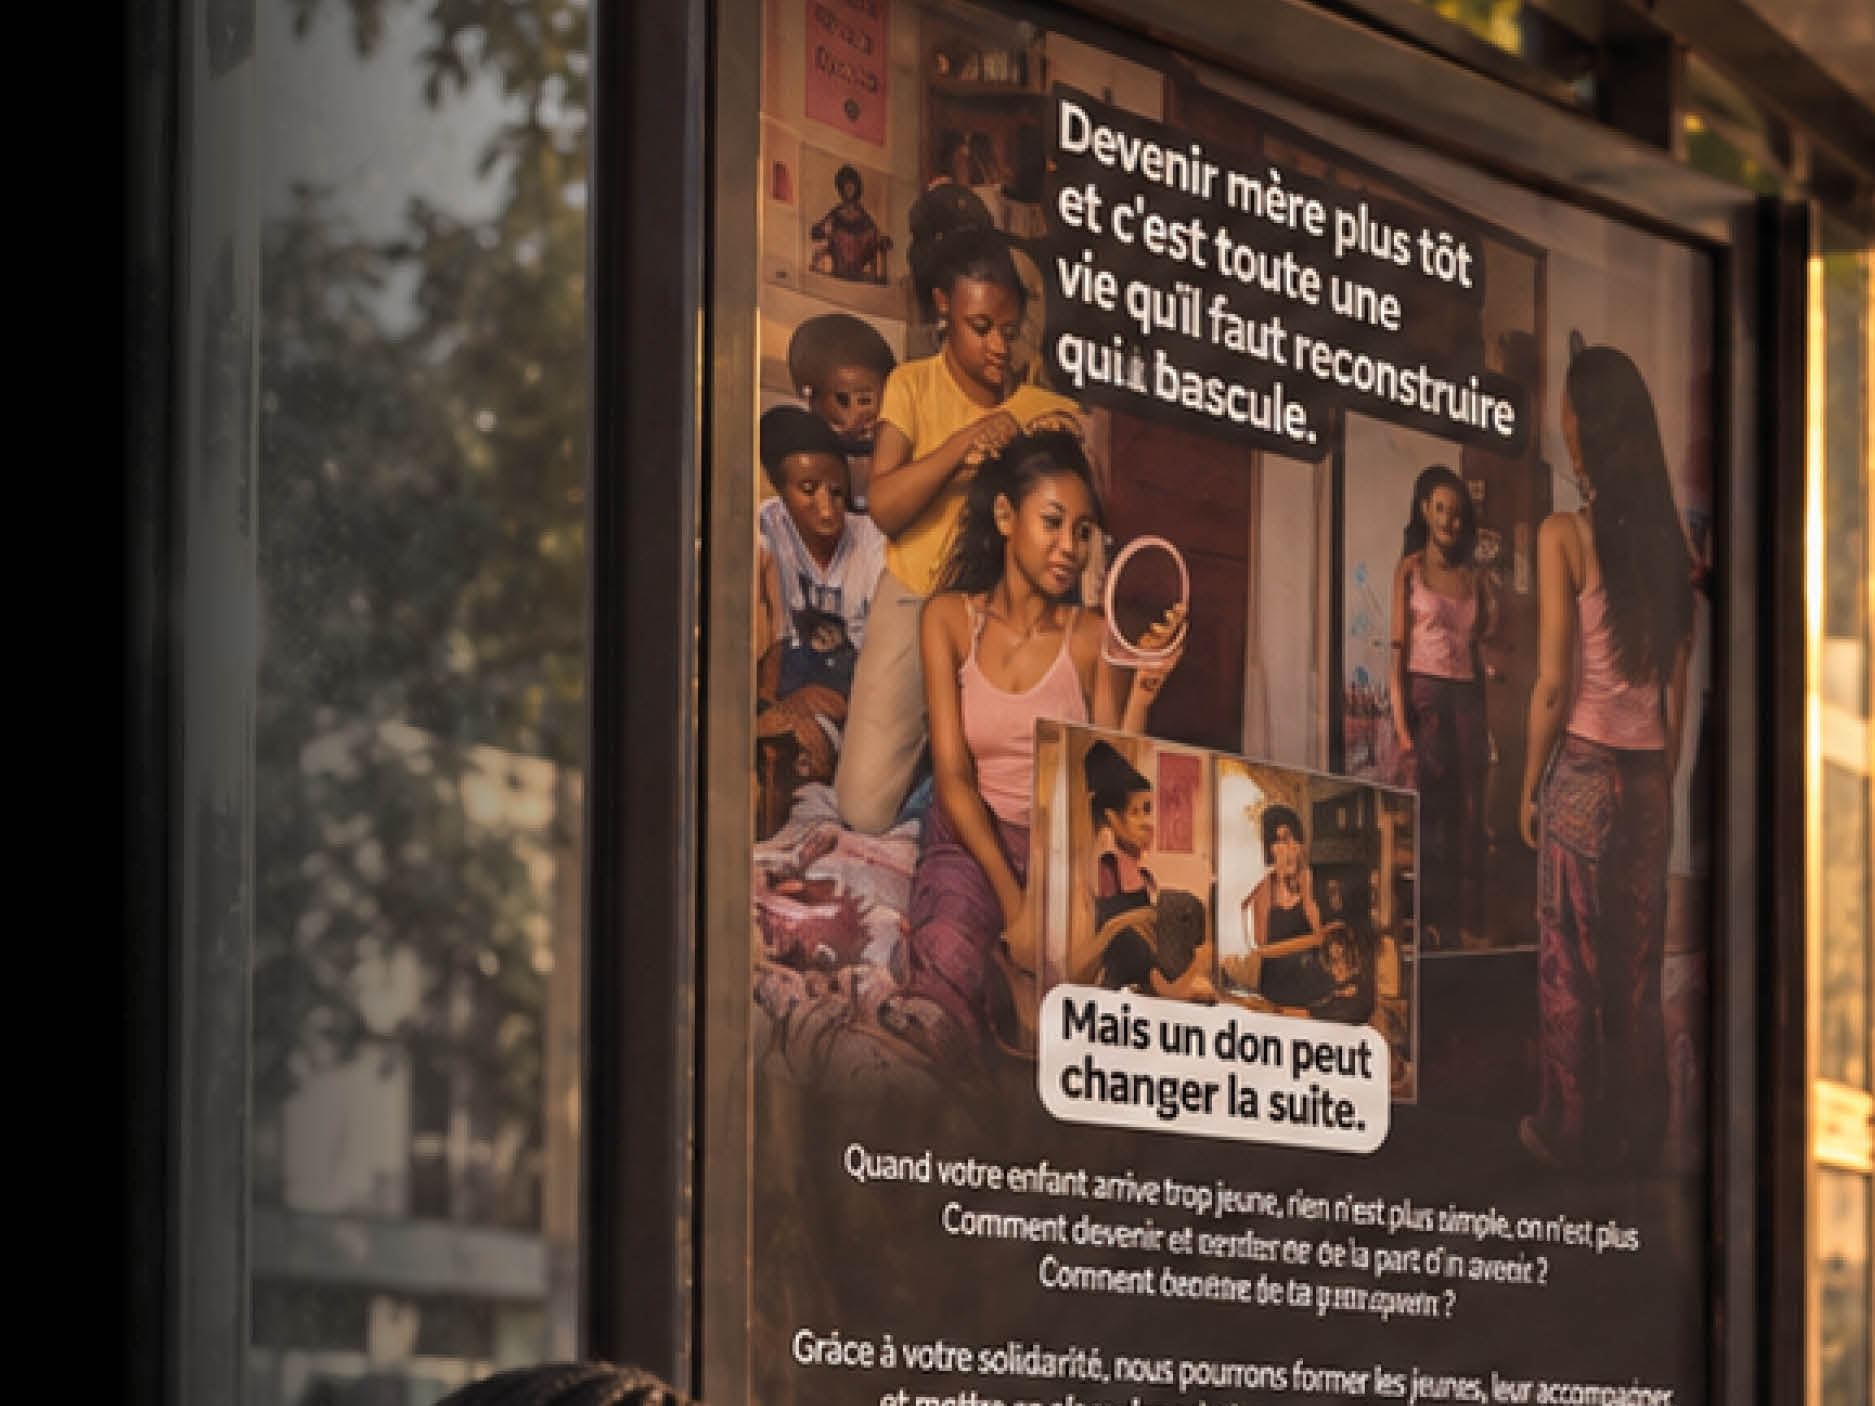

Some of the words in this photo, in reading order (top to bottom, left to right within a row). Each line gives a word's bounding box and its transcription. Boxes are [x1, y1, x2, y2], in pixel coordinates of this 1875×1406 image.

[1059, 98, 1219, 200] Devenir
[1227, 167, 1327, 238] mère
[1334, 203, 1411, 265] plus
[1417, 227, 1473, 288] tôt
[1058, 183, 1102, 233] et
[1110, 196, 1206, 268] c'est
[1214, 228, 1320, 303] toute
[1332, 275, 1401, 330] une
[1058, 250, 1118, 309] vie
[1208, 295, 1288, 364] faut
[1294, 336, 1515, 437] reconstruire
[1155, 348, 1318, 444] bascule.
[1061, 996, 1150, 1049] Mais
[1160, 1020, 1206, 1057] un
[1215, 1019, 1282, 1065] don
[1292, 1039, 1373, 1079] peut
[1060, 1053, 1220, 1120] changer
[1228, 1073, 1258, 1118] la
[1269, 1083, 1366, 1131] suite.
[844, 1143, 932, 1183] Quand
[937, 1155, 1004, 1188] votre
[1006, 1160, 1088, 1198] enfant
[940, 1201, 1070, 1245] Comment
[880, 1334, 897, 1368] à
[902, 1340, 973, 1373] votre
[1115, 1358, 1175, 1385] nous
